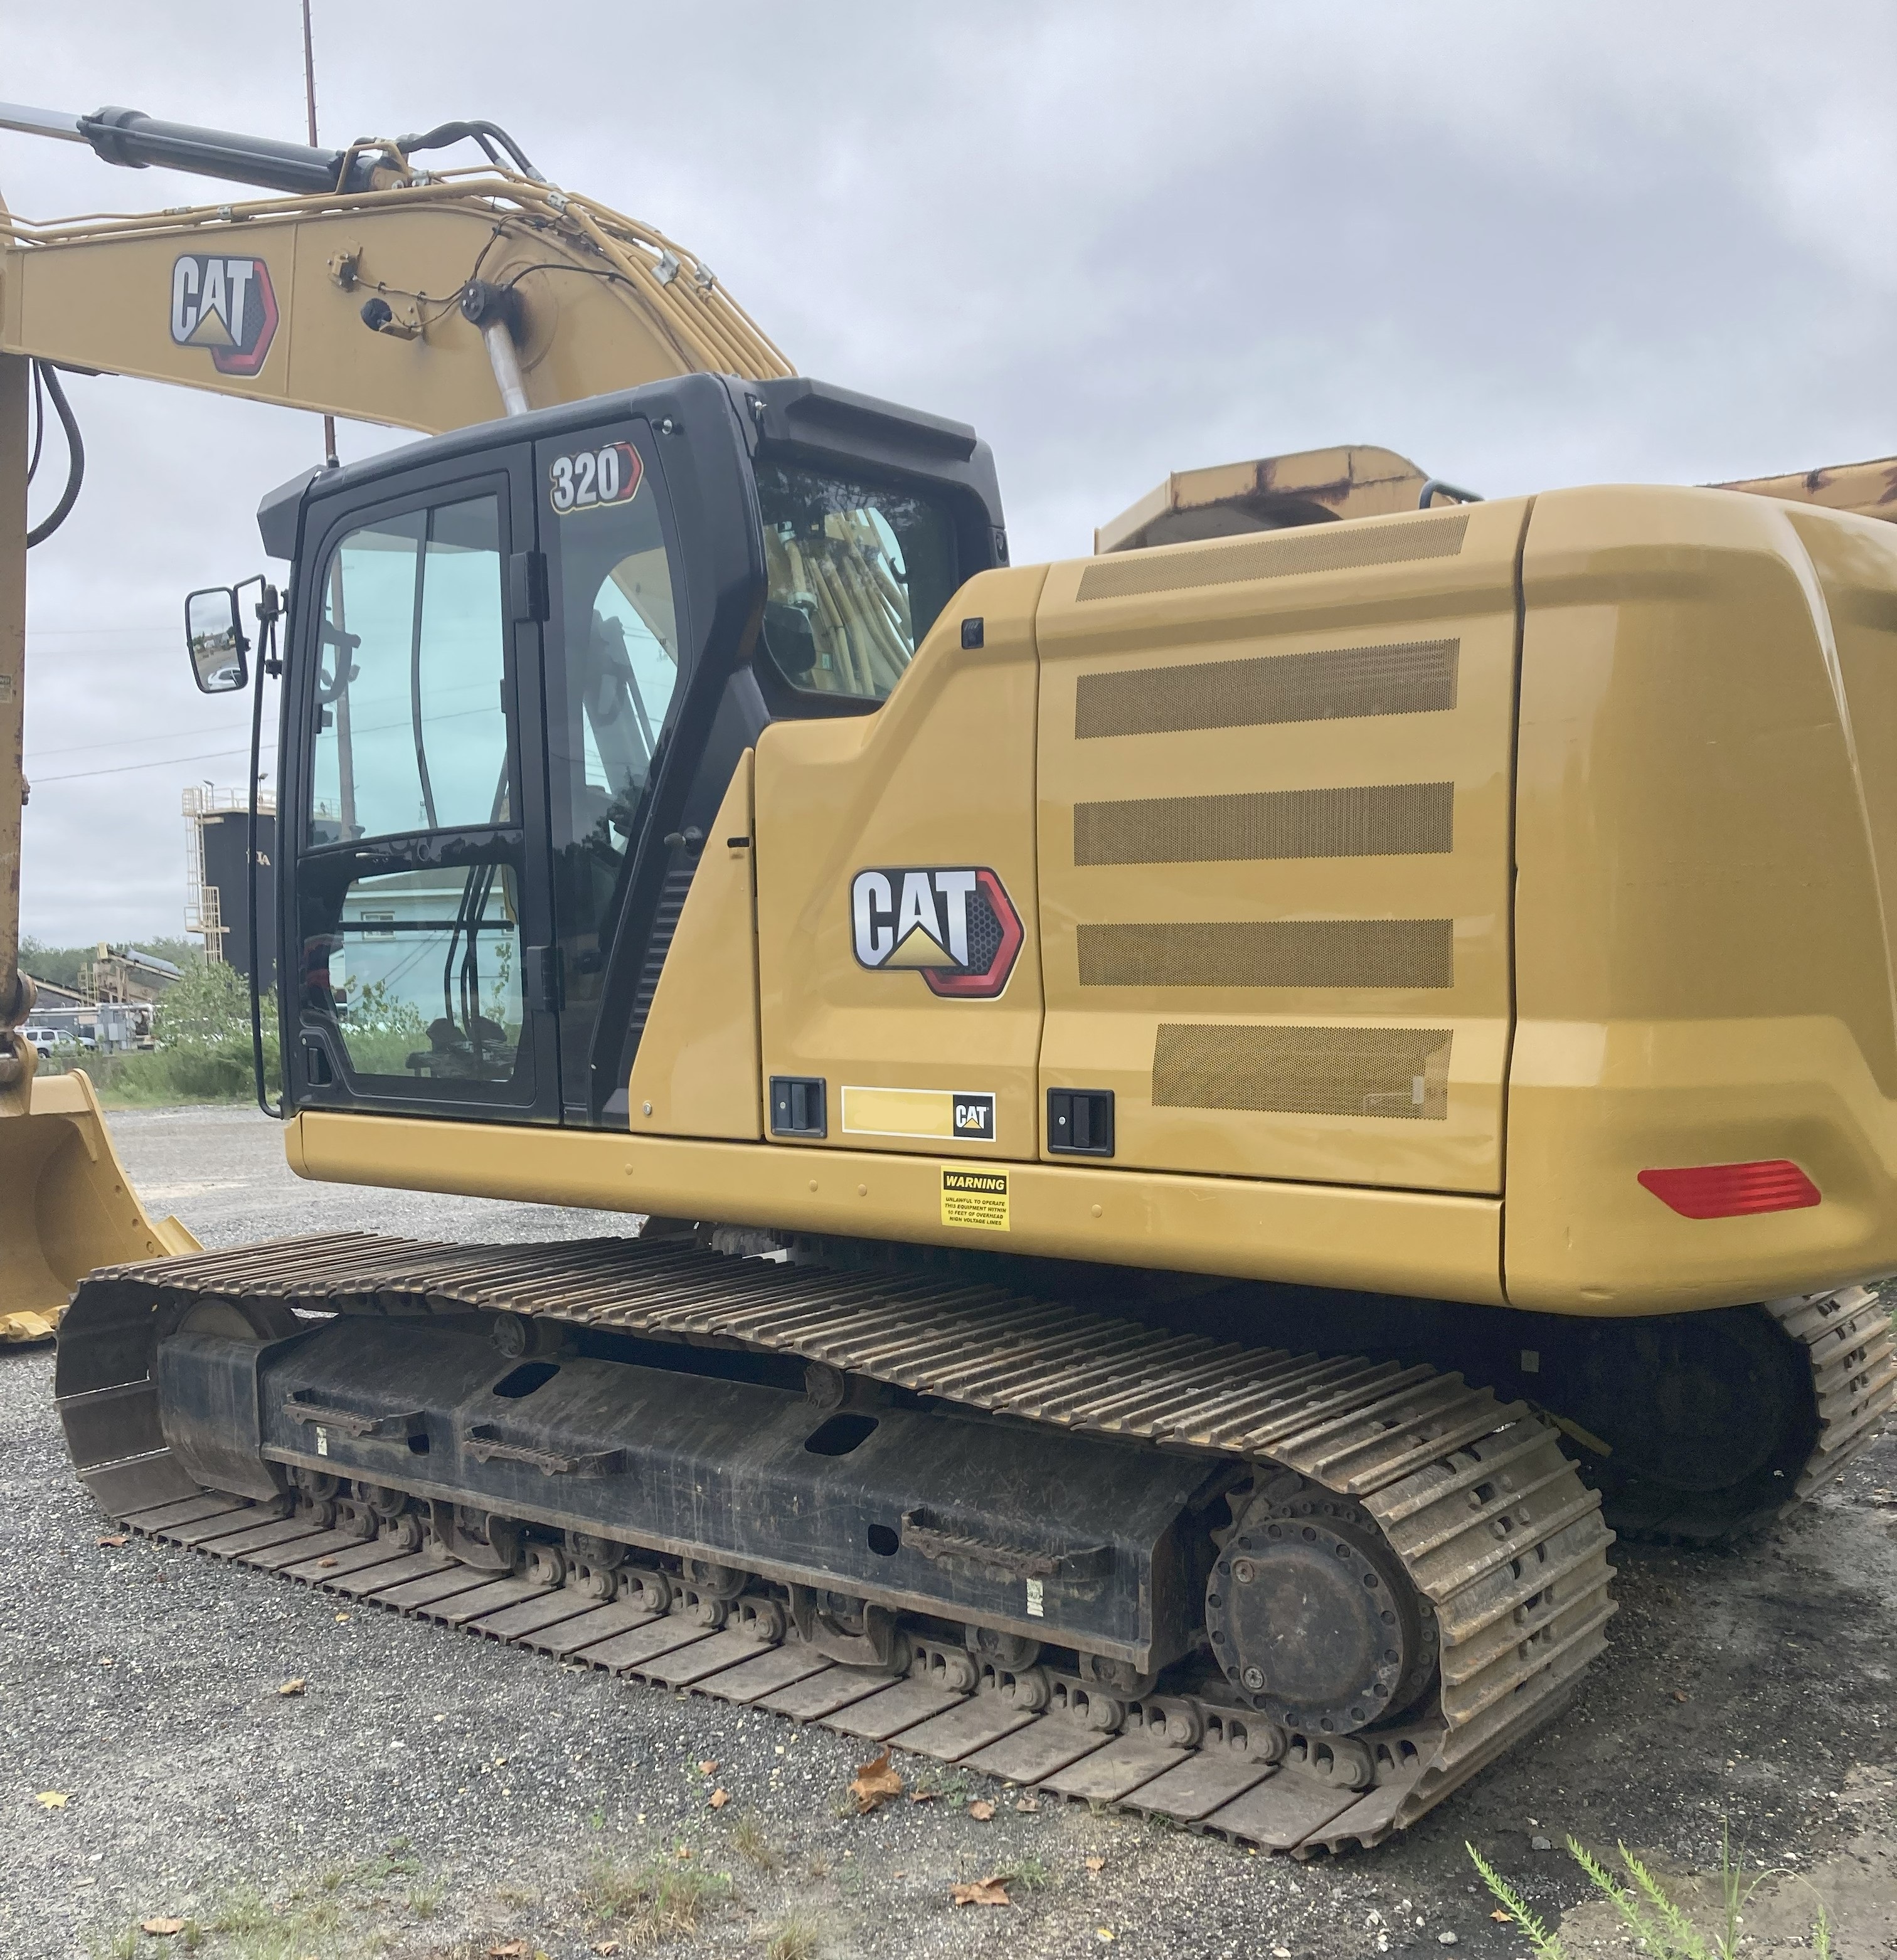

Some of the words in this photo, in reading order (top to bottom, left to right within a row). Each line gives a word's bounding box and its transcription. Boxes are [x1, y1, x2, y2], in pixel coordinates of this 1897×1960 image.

[172, 256, 253, 346] CAT
[553, 447, 619, 509] 320
[853, 871, 976, 967] CAT
[955, 1104, 987, 1129] CAT
[946, 1175, 1005, 1190] WARNING
